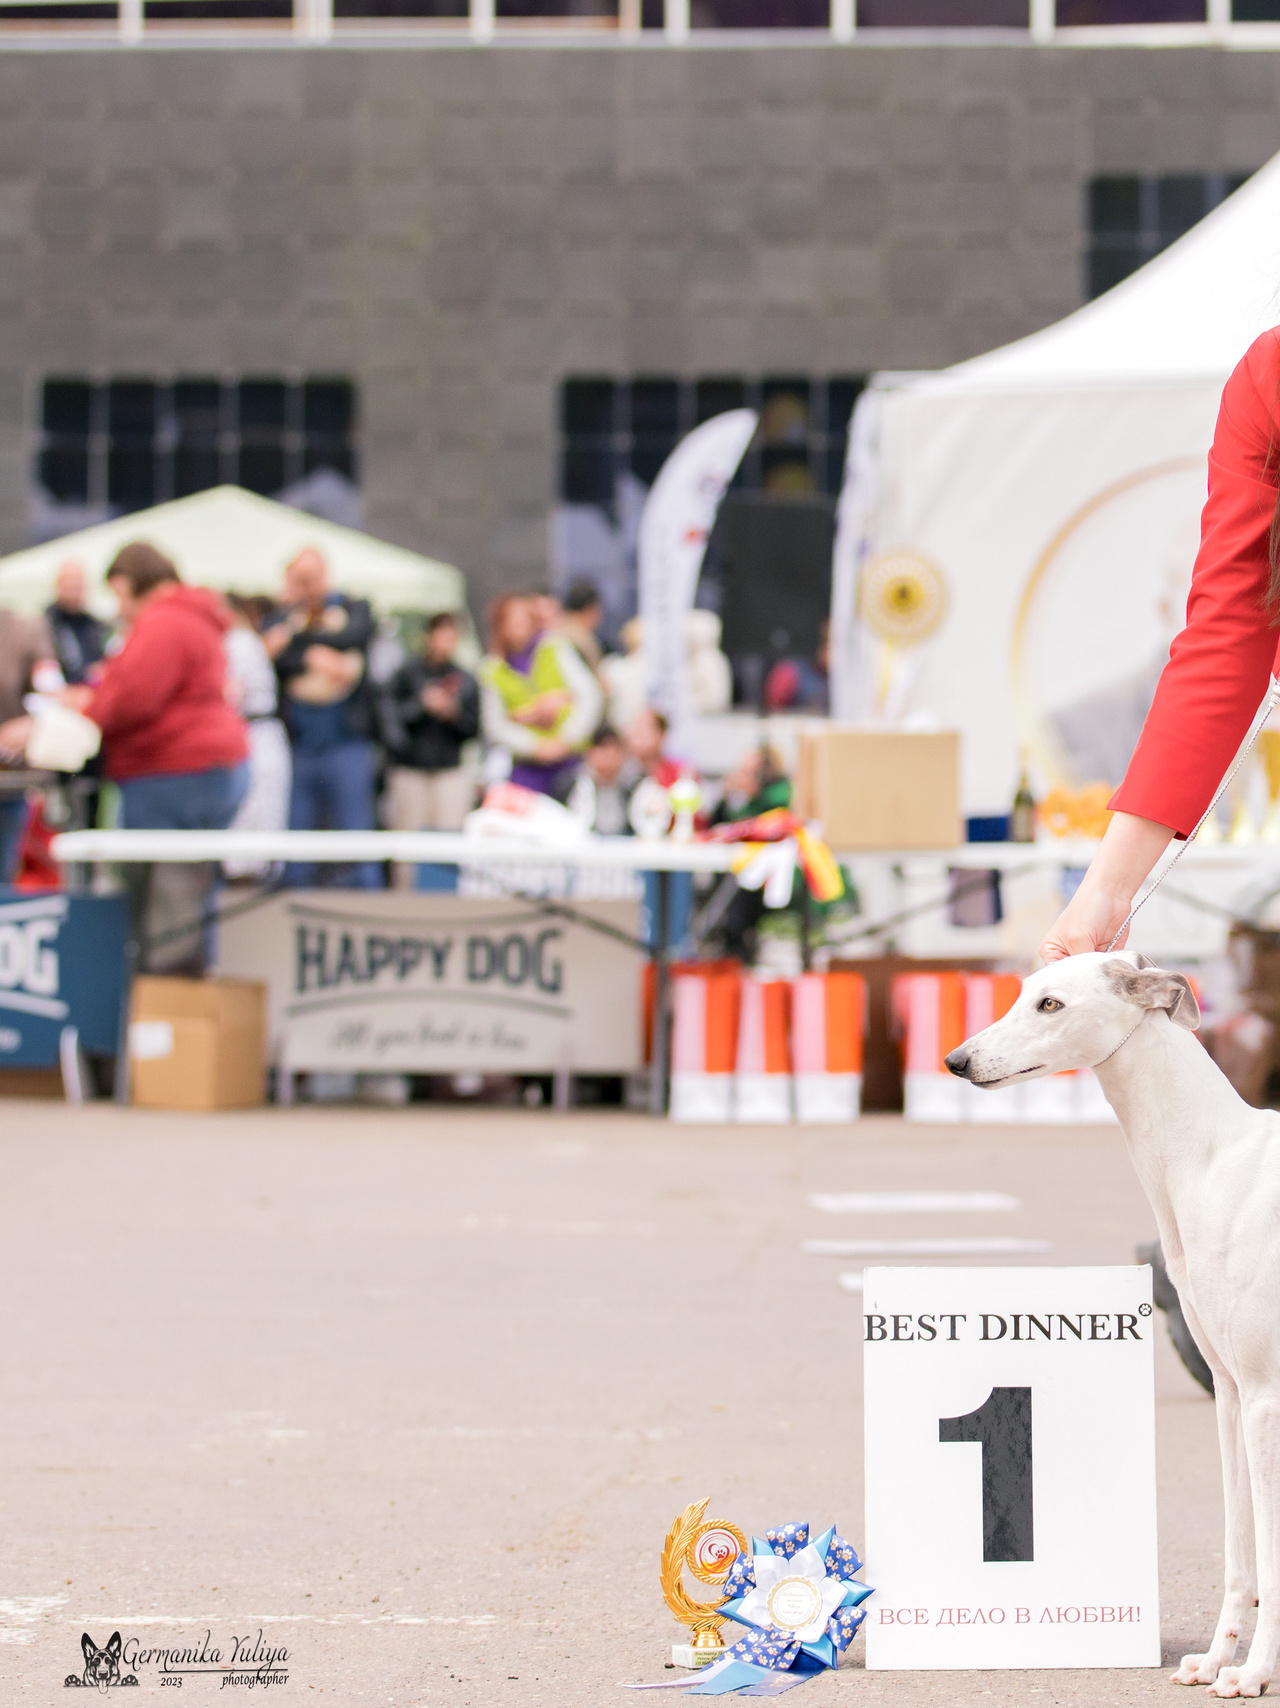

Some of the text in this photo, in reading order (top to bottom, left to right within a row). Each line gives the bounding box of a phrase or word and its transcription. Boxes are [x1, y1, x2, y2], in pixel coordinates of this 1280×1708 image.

[0, 919, 60, 995] OG
[295, 924, 562, 995] HAPPY DOG
[864, 1313, 1143, 1342] BEST DINNER
[938, 1386, 1035, 1563] 1
[878, 1605, 1141, 1628] ВСЕ ДЕЛО В ЛЮБВИ!
